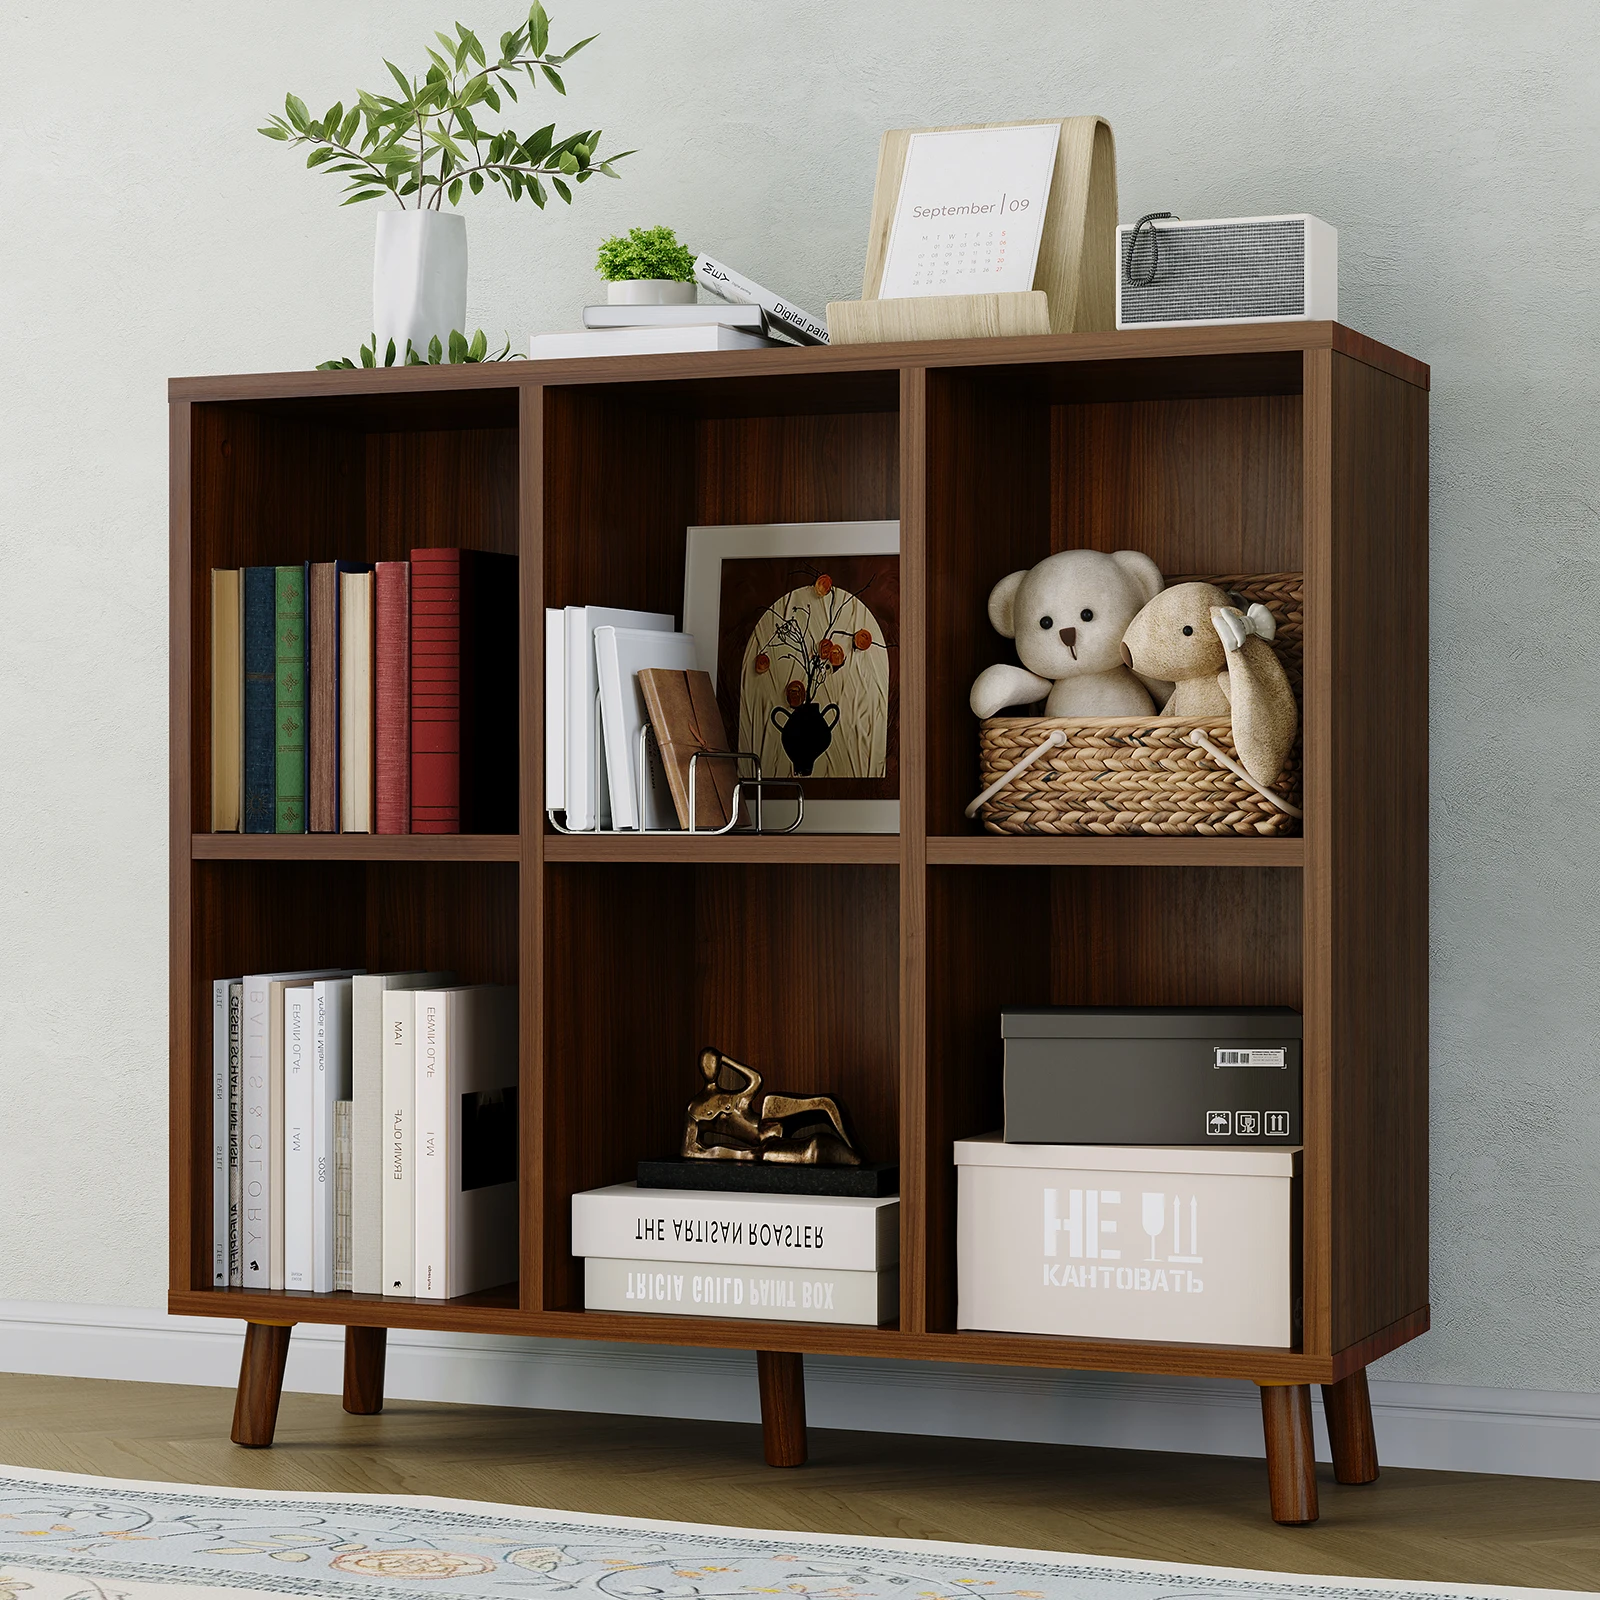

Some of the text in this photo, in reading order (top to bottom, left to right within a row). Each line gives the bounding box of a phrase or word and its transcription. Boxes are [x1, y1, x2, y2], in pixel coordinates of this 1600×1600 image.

[913, 199, 1030, 219] September 09
[773, 303, 807, 327] Digital
[1044, 1188, 1121, 1260] НЕ
[1043, 1263, 1204, 1294] КАНТОВАТЬ
